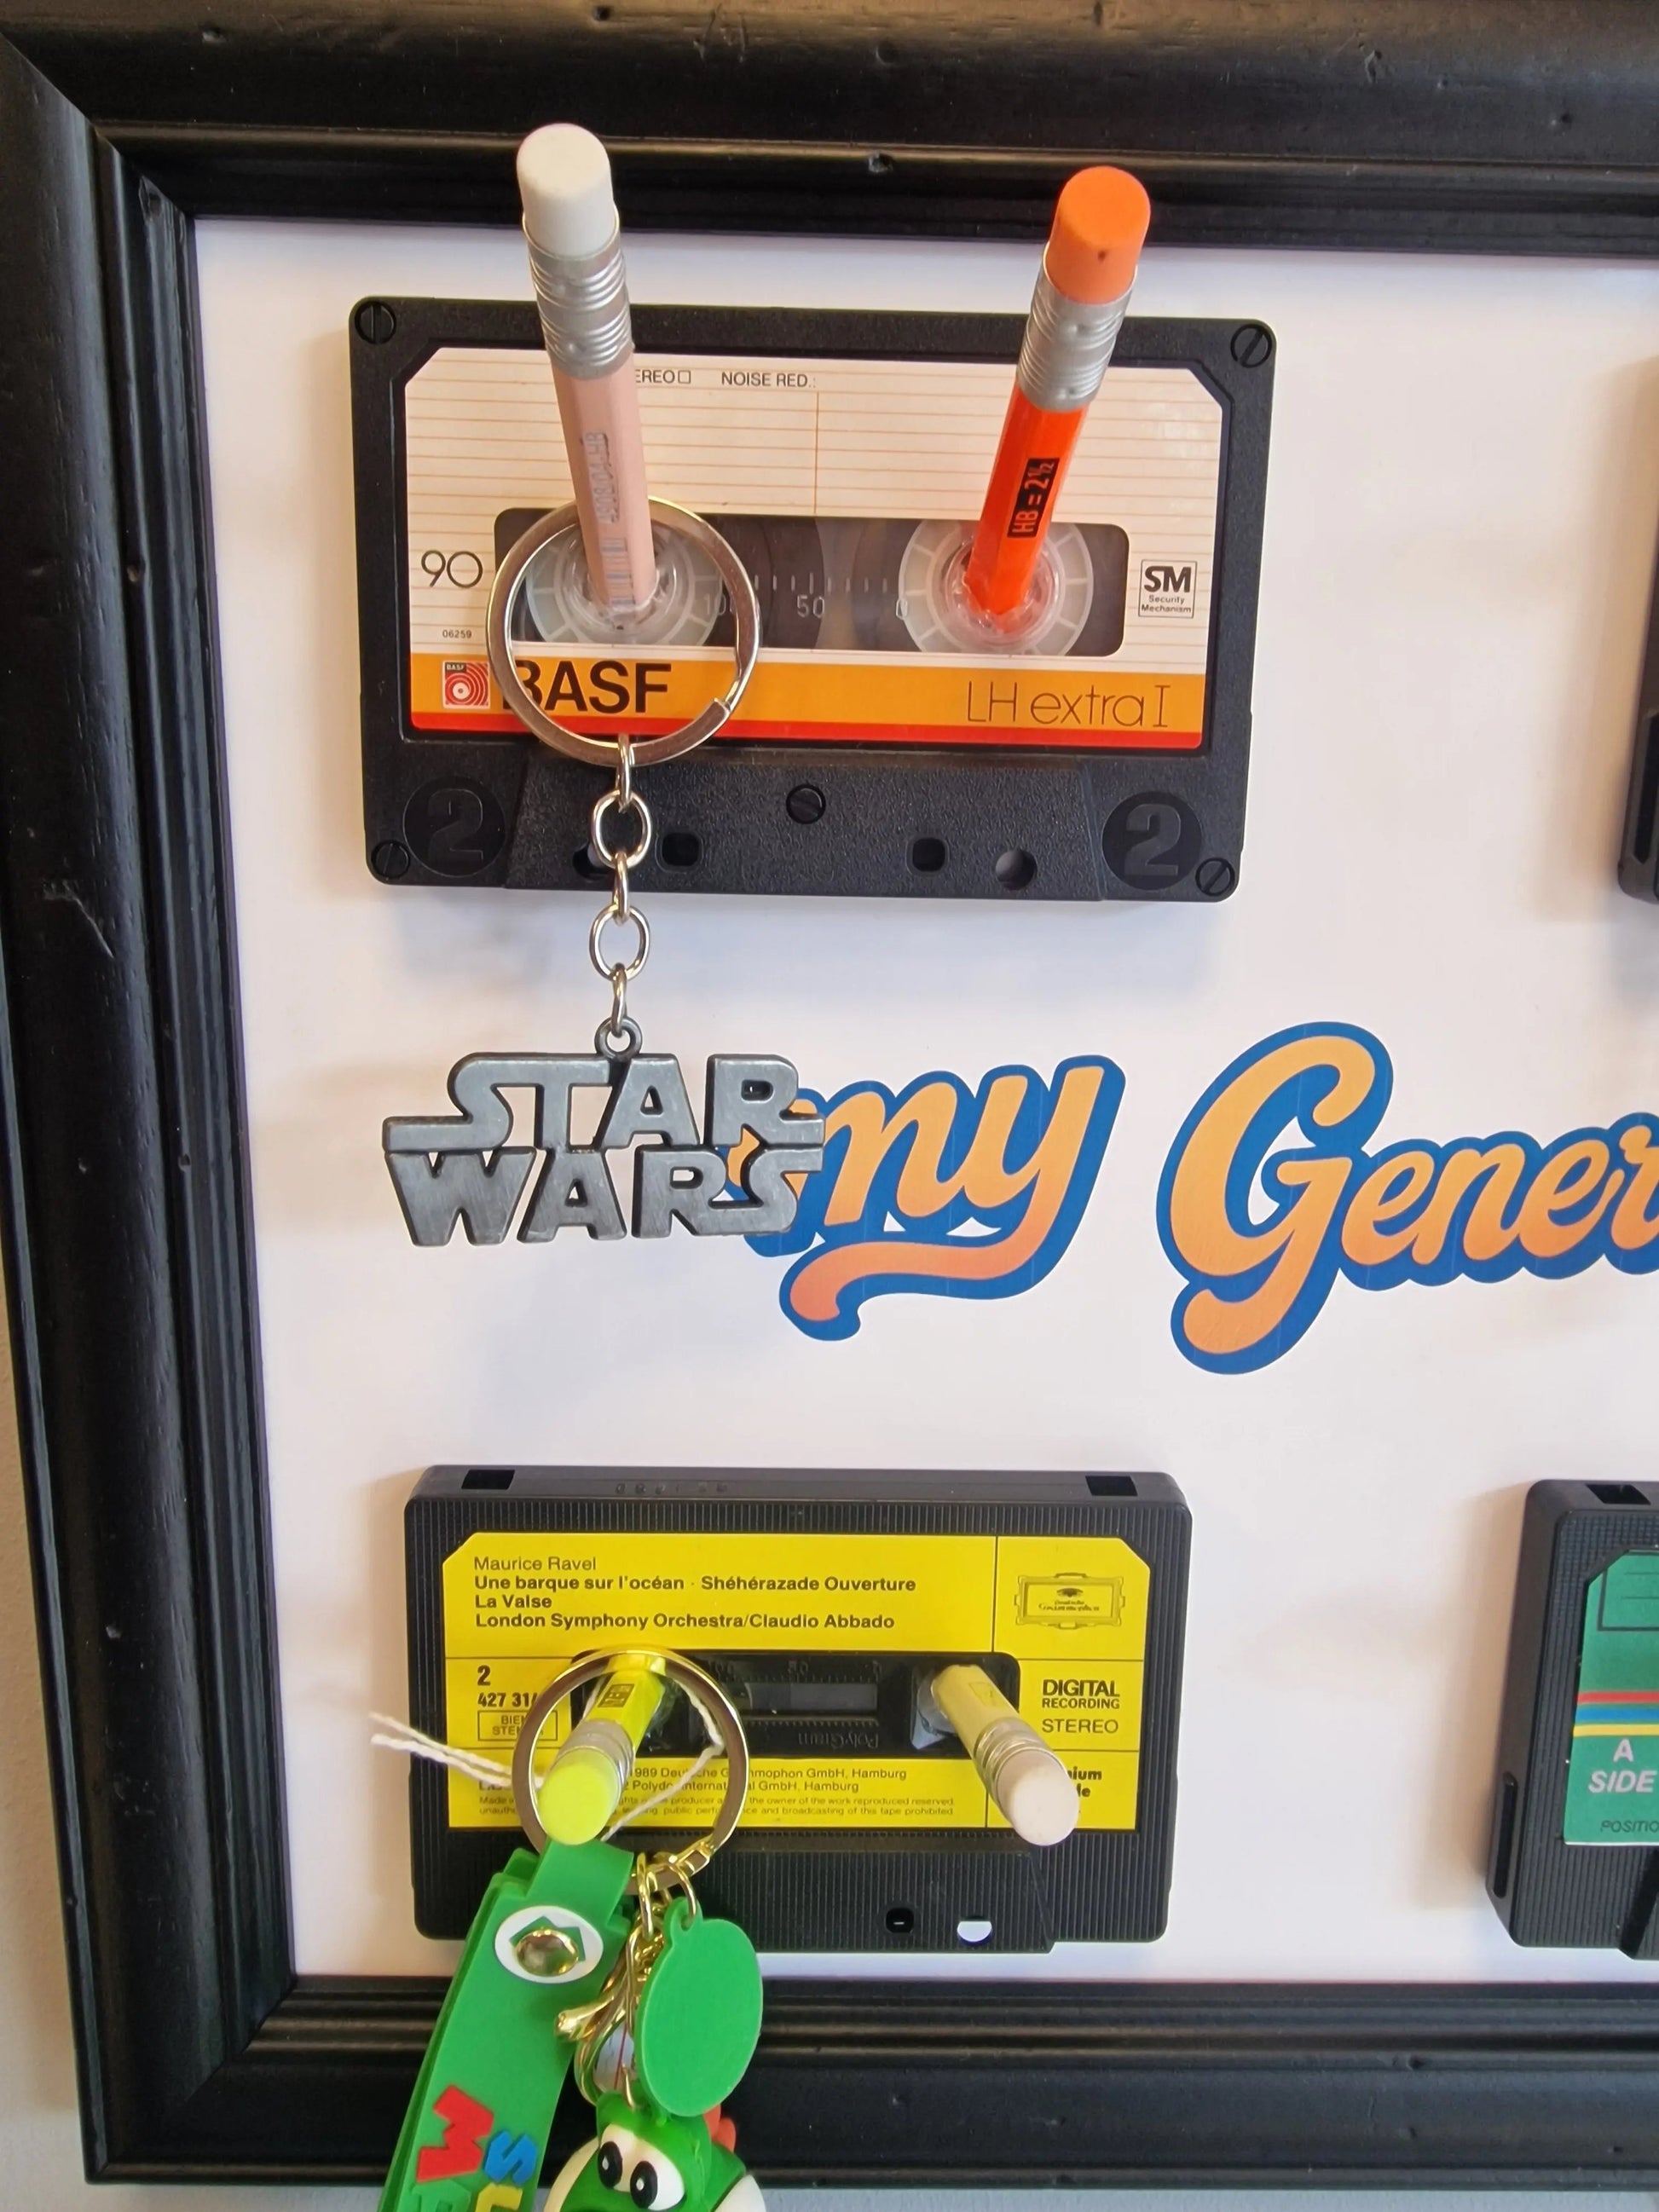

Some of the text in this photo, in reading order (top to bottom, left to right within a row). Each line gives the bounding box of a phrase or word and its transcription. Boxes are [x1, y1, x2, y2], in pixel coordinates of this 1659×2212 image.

[635, 369, 675, 384] EREO
[721, 372, 772, 386] NOISE
[1012, 511, 1038, 533] HB
[421, 550, 483, 588] 90
[1143, 565, 1192, 593] SM
[796, 594, 825, 618] 50
[1148, 595, 1185, 604] Security
[1142, 604, 1192, 613] Mechanism
[442, 629, 472, 638] 06259
[968, 680, 1018, 723] LH
[1030, 684, 1145, 727] extra
[428, 788, 483, 864] 2
[1124, 804, 1182, 875] 2
[383, 1053, 824, 1151] STAR
[384, 1145, 824, 1247] WARS
[473, 1556, 596, 1571] Maurice Ravel
[475, 1576, 916, 1592] Une barque sur l'océan Shéhérazade Ouverture
[475, 1595, 552, 1608] La Valse
[476, 1613, 895, 1631] London Symphony Orchestra/Claudio Abbado
[477, 1665, 491, 1686] 2
[1043, 1679, 1120, 1697] DIGITAL
[477, 1693, 506, 1707] 427
[1042, 1698, 1120, 1709] RECORDING
[1042, 1718, 1119, 1734] STEREO
[1613, 1737, 1635, 1763] A
[661, 1767, 718, 1778] Deuche
[852, 1768, 907, 1782] Hamburg
[1588, 1770, 1658, 1793] SIDE
[633, 1780, 673, 1792] Polyd
[804, 1782, 859, 1793] Hamburg
[671, 1797, 714, 1807] producer
[853, 1798, 910, 1806] reproduced
[783, 1806, 844, 1816] broadcasting
[881, 1807, 901, 1816] tape
